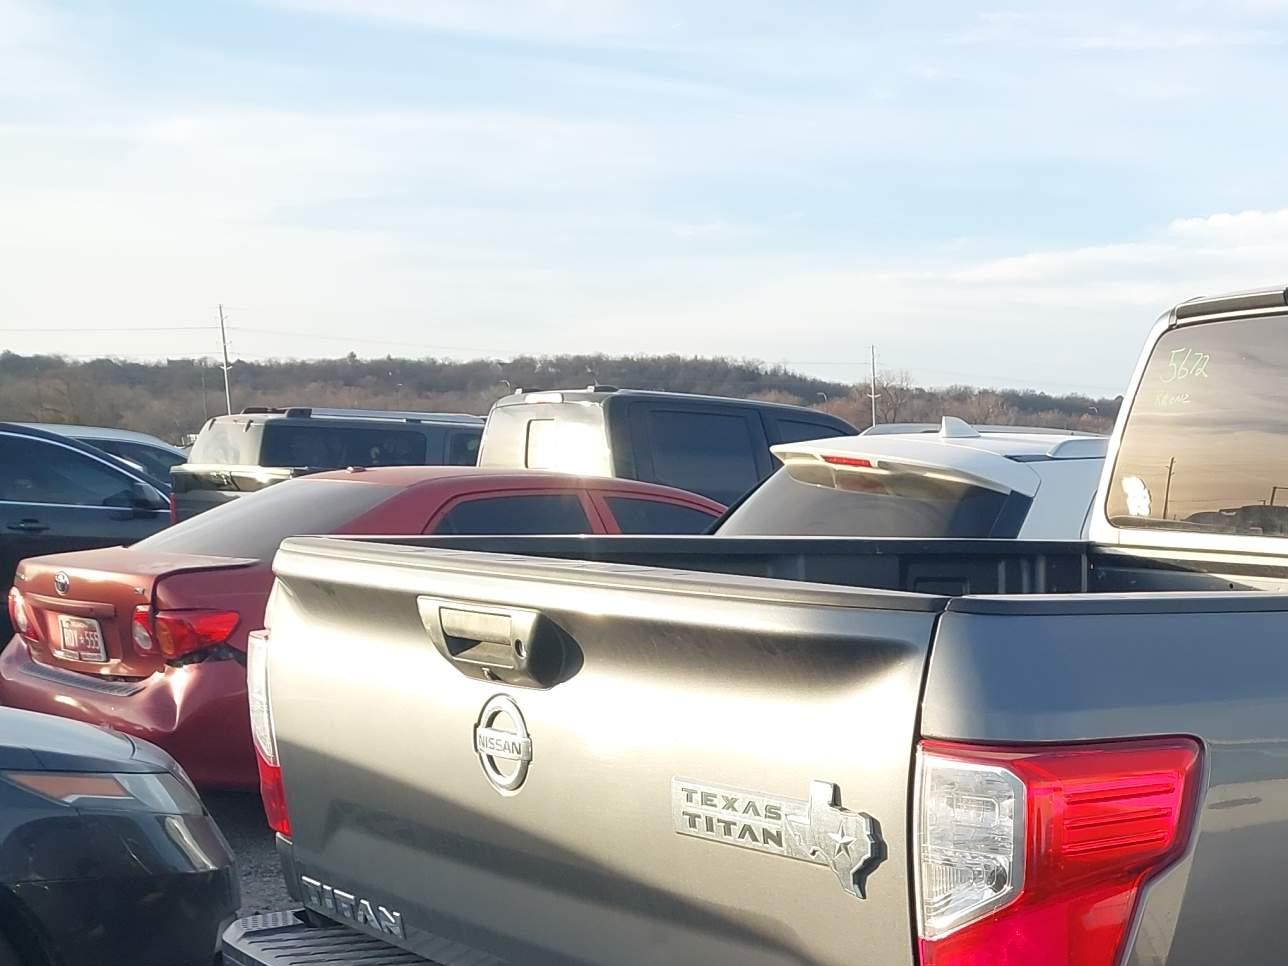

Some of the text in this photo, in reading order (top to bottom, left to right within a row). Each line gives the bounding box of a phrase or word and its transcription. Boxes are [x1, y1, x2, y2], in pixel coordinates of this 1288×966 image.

[478, 735, 522, 756] NISSAN
[681, 787, 782, 821] TEXAS
[681, 810, 784, 848] TITAN
[301, 875, 406, 939] TITAN
